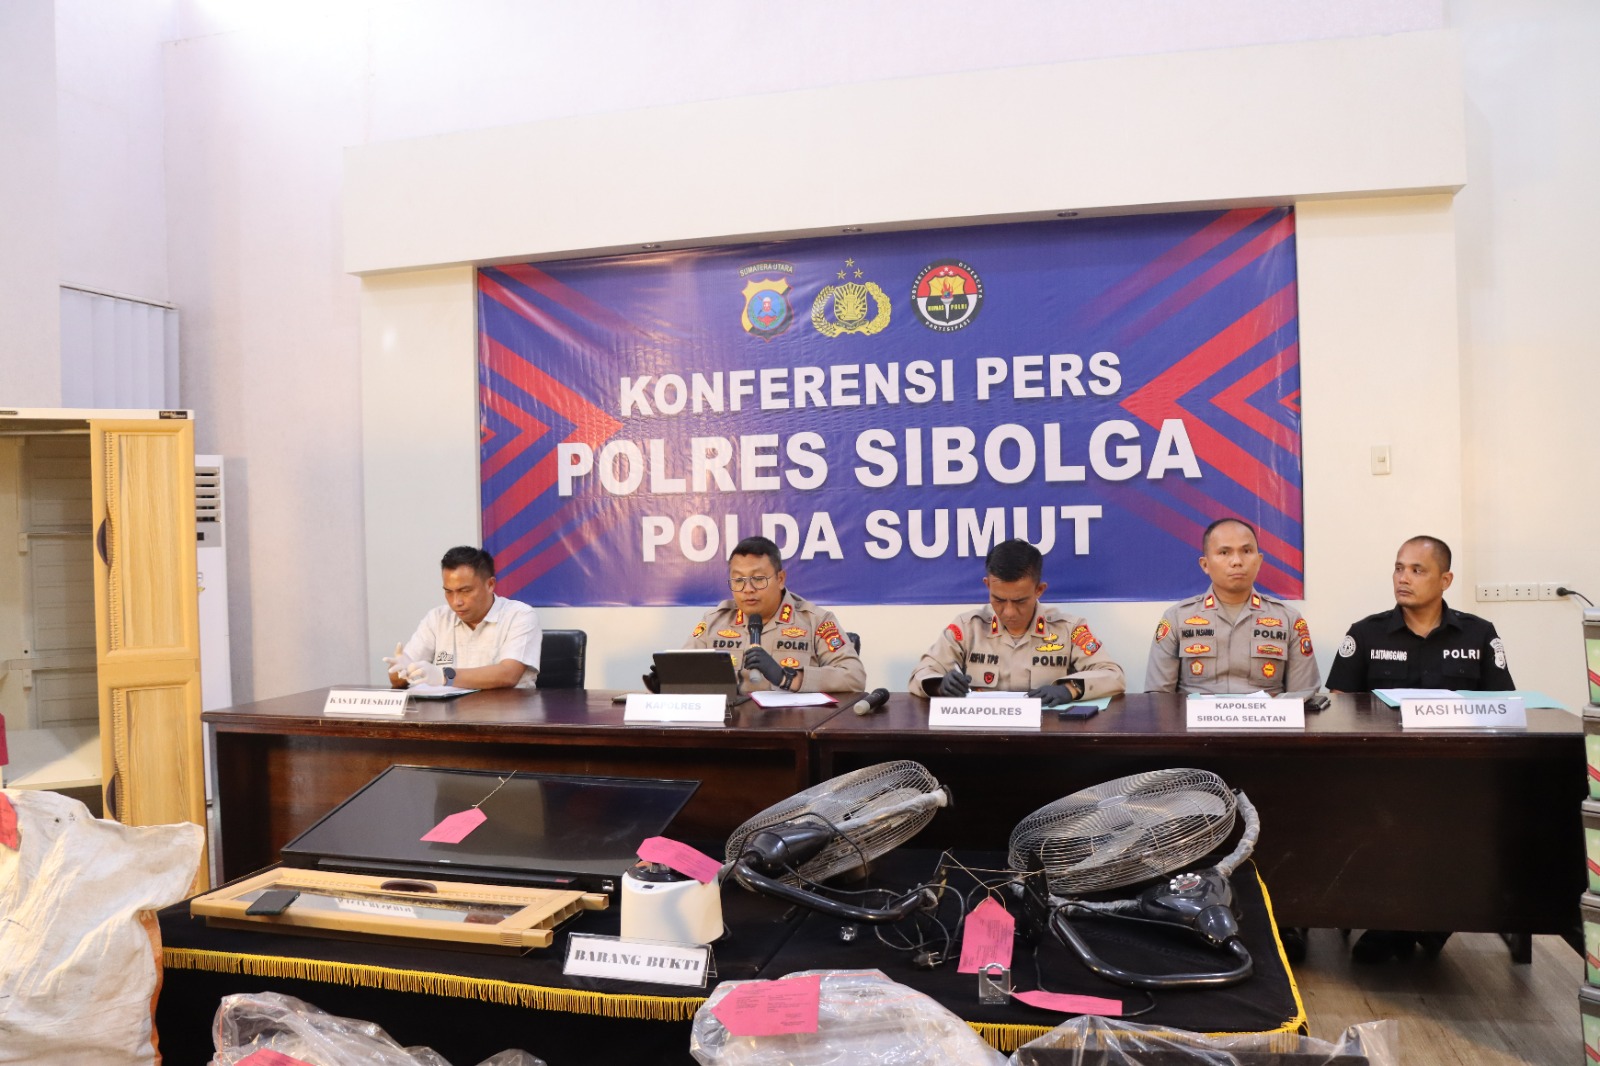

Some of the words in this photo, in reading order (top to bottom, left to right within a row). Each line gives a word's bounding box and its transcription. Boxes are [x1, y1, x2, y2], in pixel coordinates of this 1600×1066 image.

[739, 263, 772, 277] SUMATERA
[773, 263, 793, 273] UTARA
[619, 359, 955, 418] KONFERENSI
[977, 351, 1123, 402] PERS
[556, 431, 830, 498] POLRES
[854, 418, 1203, 490] SIBOLGA
[641, 511, 845, 563] POLDA
[864, 504, 1103, 560] SUMUT
[1253, 629, 1287, 641] POLRI
[712, 639, 743, 649] EDDY
[776, 640, 809, 652] POLRI
[1443, 648, 1480, 660] POLRI
[1031, 655, 1068, 667] POLRI
[329, 696, 358, 705] KASAT
[359, 697, 403, 706] RESKRIM
[645, 700, 702, 711] KAPOLRES
[1215, 702, 1267, 710] KAPOLSEK
[940, 705, 1023, 716] WAKAPOLRES
[1414, 703, 1450, 716] KASI
[1453, 702, 1507, 716] HUMAS
[1196, 714, 1239, 722] SIBOLGA
[1242, 714, 1286, 722] SELATAN
[573, 949, 641, 967] BARANG
[646, 956, 700, 971] BUKTI
